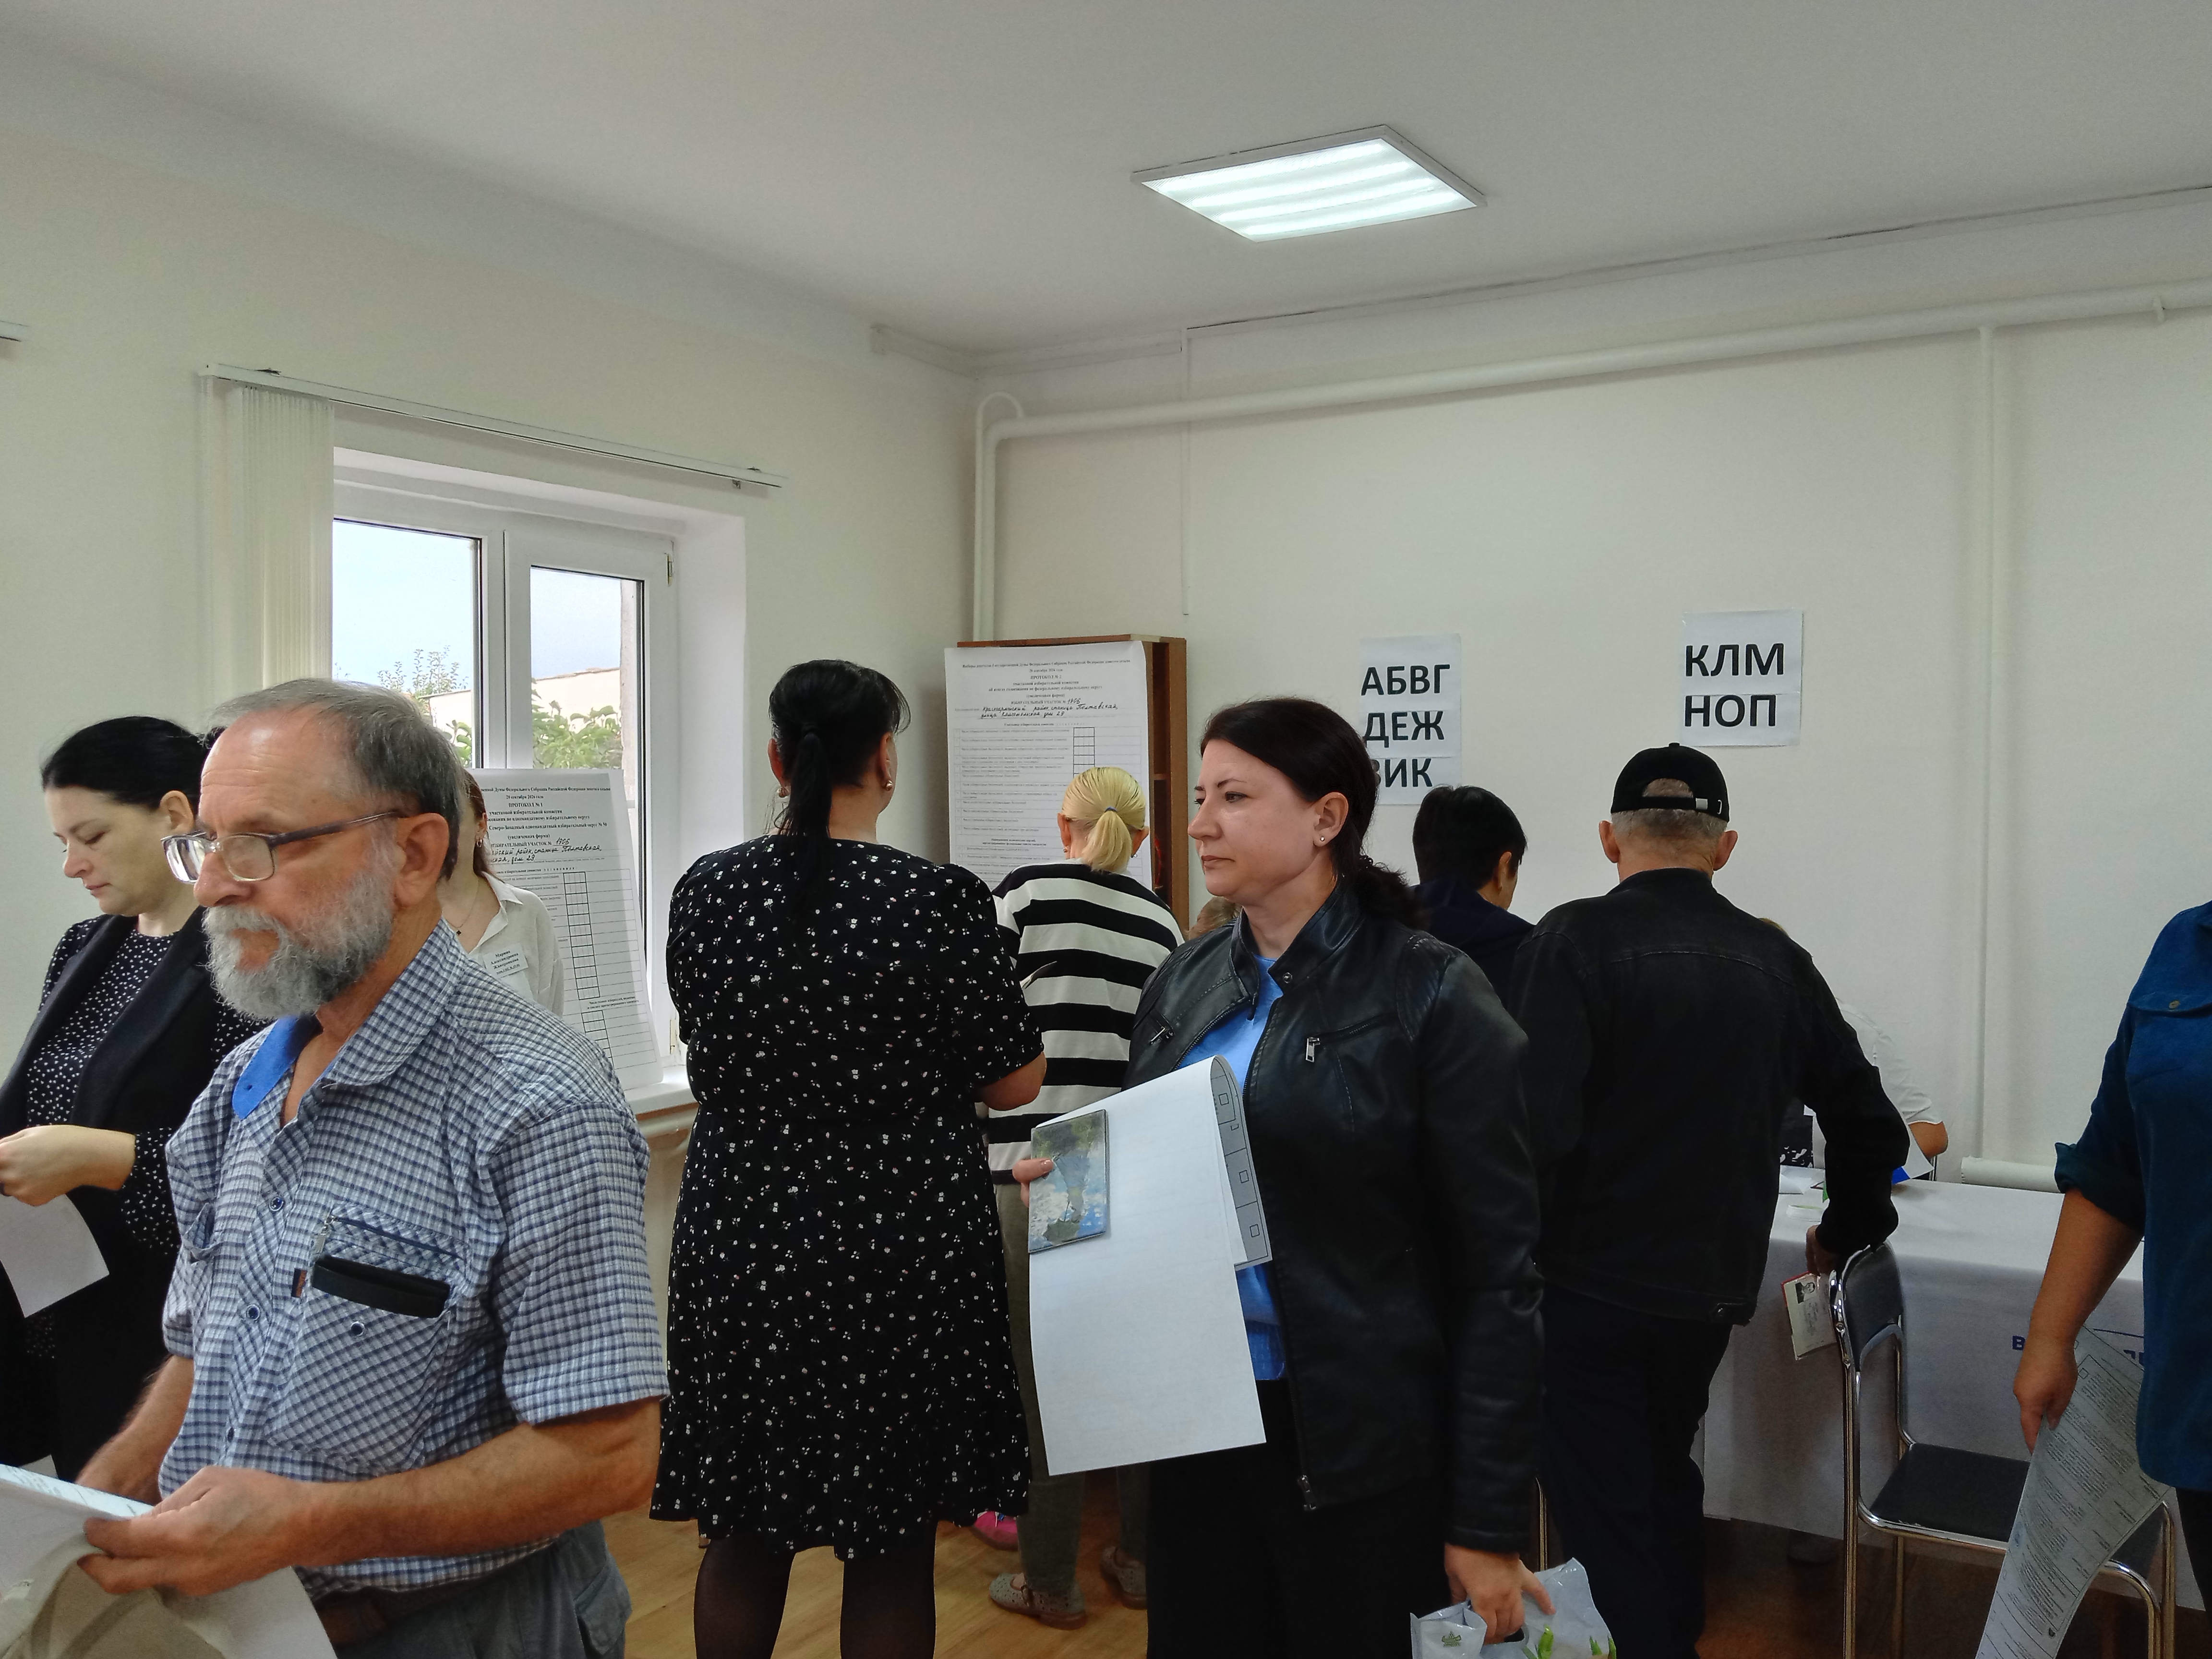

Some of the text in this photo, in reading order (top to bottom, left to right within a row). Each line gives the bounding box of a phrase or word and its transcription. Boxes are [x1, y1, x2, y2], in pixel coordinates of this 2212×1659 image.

[1685, 643, 1784, 676] КЛМ
[1361, 664, 1450, 696] АБВГ
[1684, 695, 1776, 727] НОП
[1362, 711, 1445, 748] ДЕЖ
[555, 837, 570, 845] 1906
